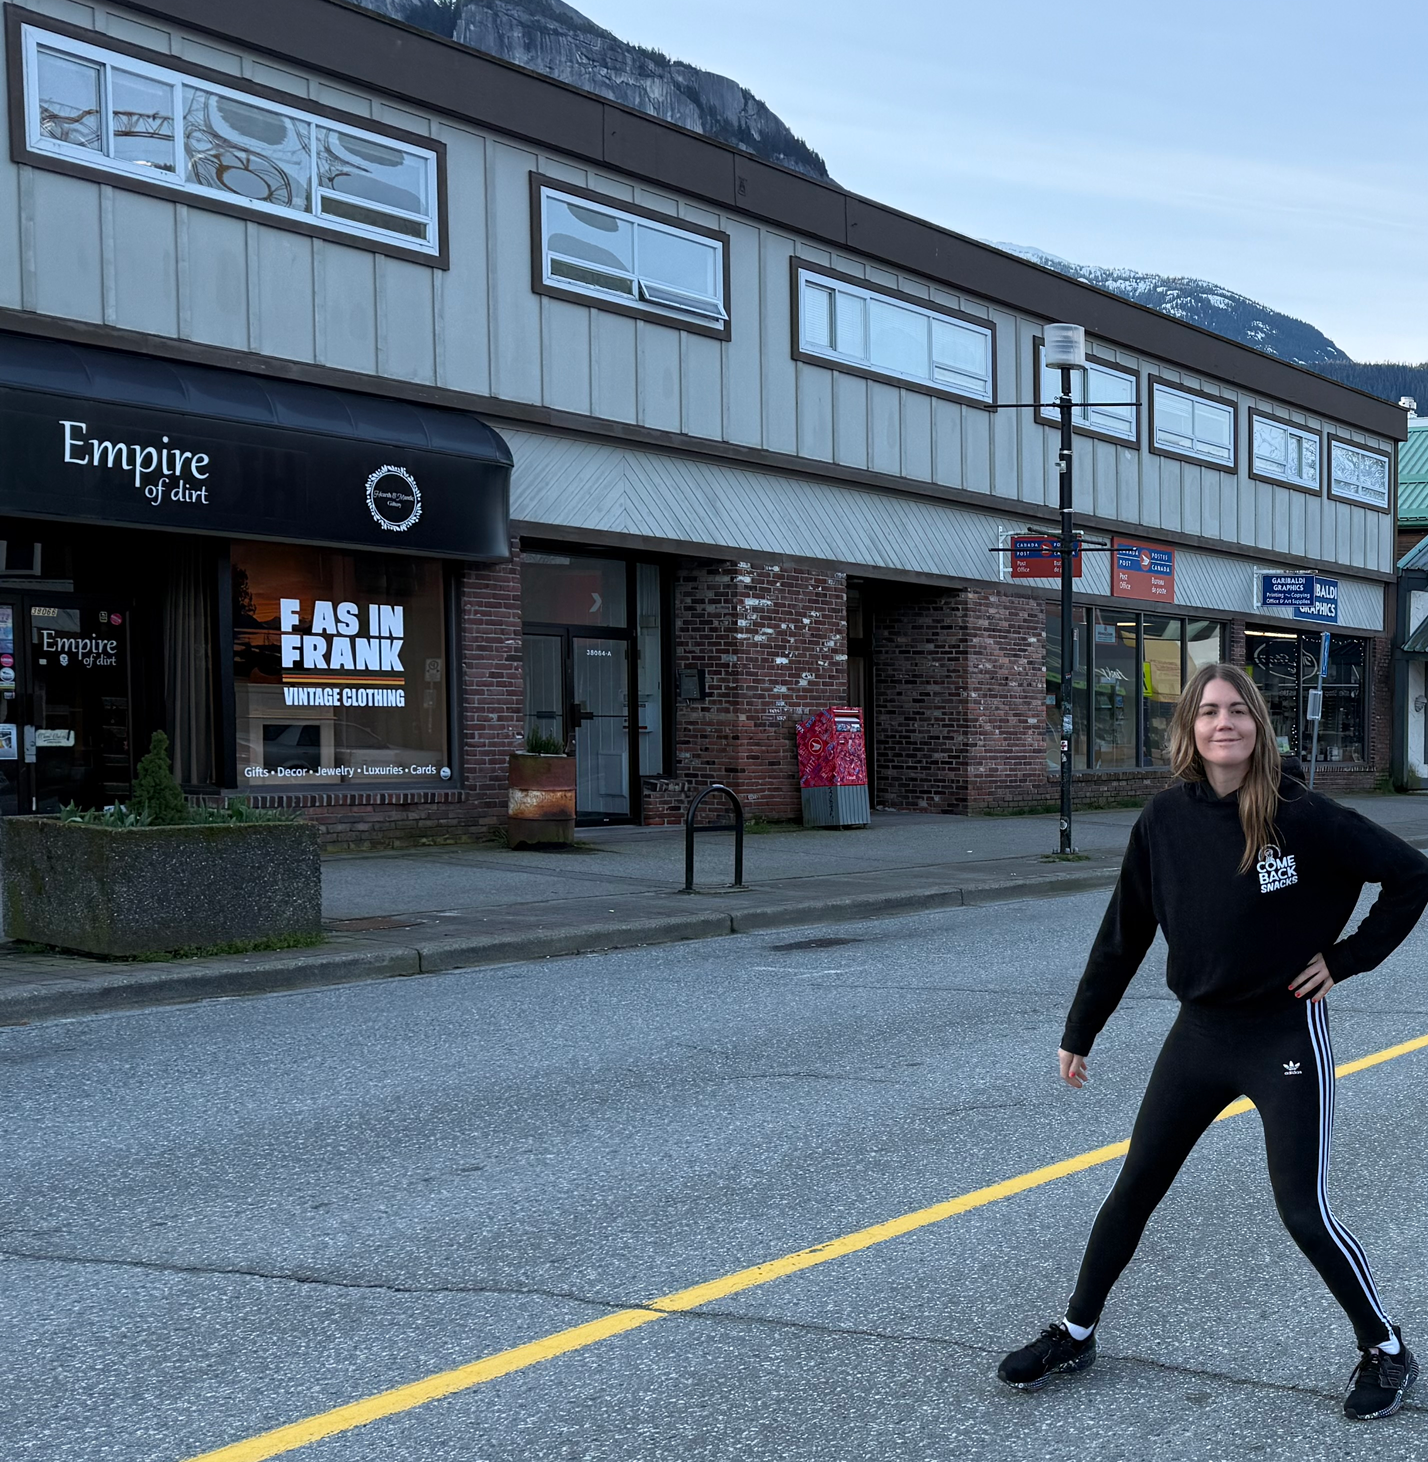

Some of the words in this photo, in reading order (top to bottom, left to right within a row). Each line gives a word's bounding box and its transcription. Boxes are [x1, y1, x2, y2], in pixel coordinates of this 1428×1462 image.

[58, 420, 210, 488] Empire
[144, 477, 170, 506] of
[170, 479, 210, 505] dirt
[1119, 559, 1131, 567] POST
[1151, 564, 1170, 572] CANADA
[1120, 572, 1128, 580] Post
[1151, 576, 1165, 586] Bureau
[1120, 581, 1131, 590] Office
[32, 607, 57, 616] 38066
[280, 598, 300, 632] F
[311, 600, 360, 636] AS
[368, 603, 404, 638] IN
[40, 630, 117, 660] Empire
[281, 634, 405, 672] FRANK
[83, 654, 96, 669] of
[96, 654, 117, 666] dirt
[283, 687, 341, 706] VINTAGE
[342, 688, 405, 707] CLOTHING
[244, 766, 269, 778] Gifts
[277, 767, 307, 778] Decor
[315, 765, 355, 778] Jewelry
[363, 764, 404, 775] Luxuries
[410, 764, 437, 775] Cards
[1257, 855, 1296, 873] COME
[1259, 865, 1297, 884] BACK
[1261, 876, 1298, 893] SNACKS
